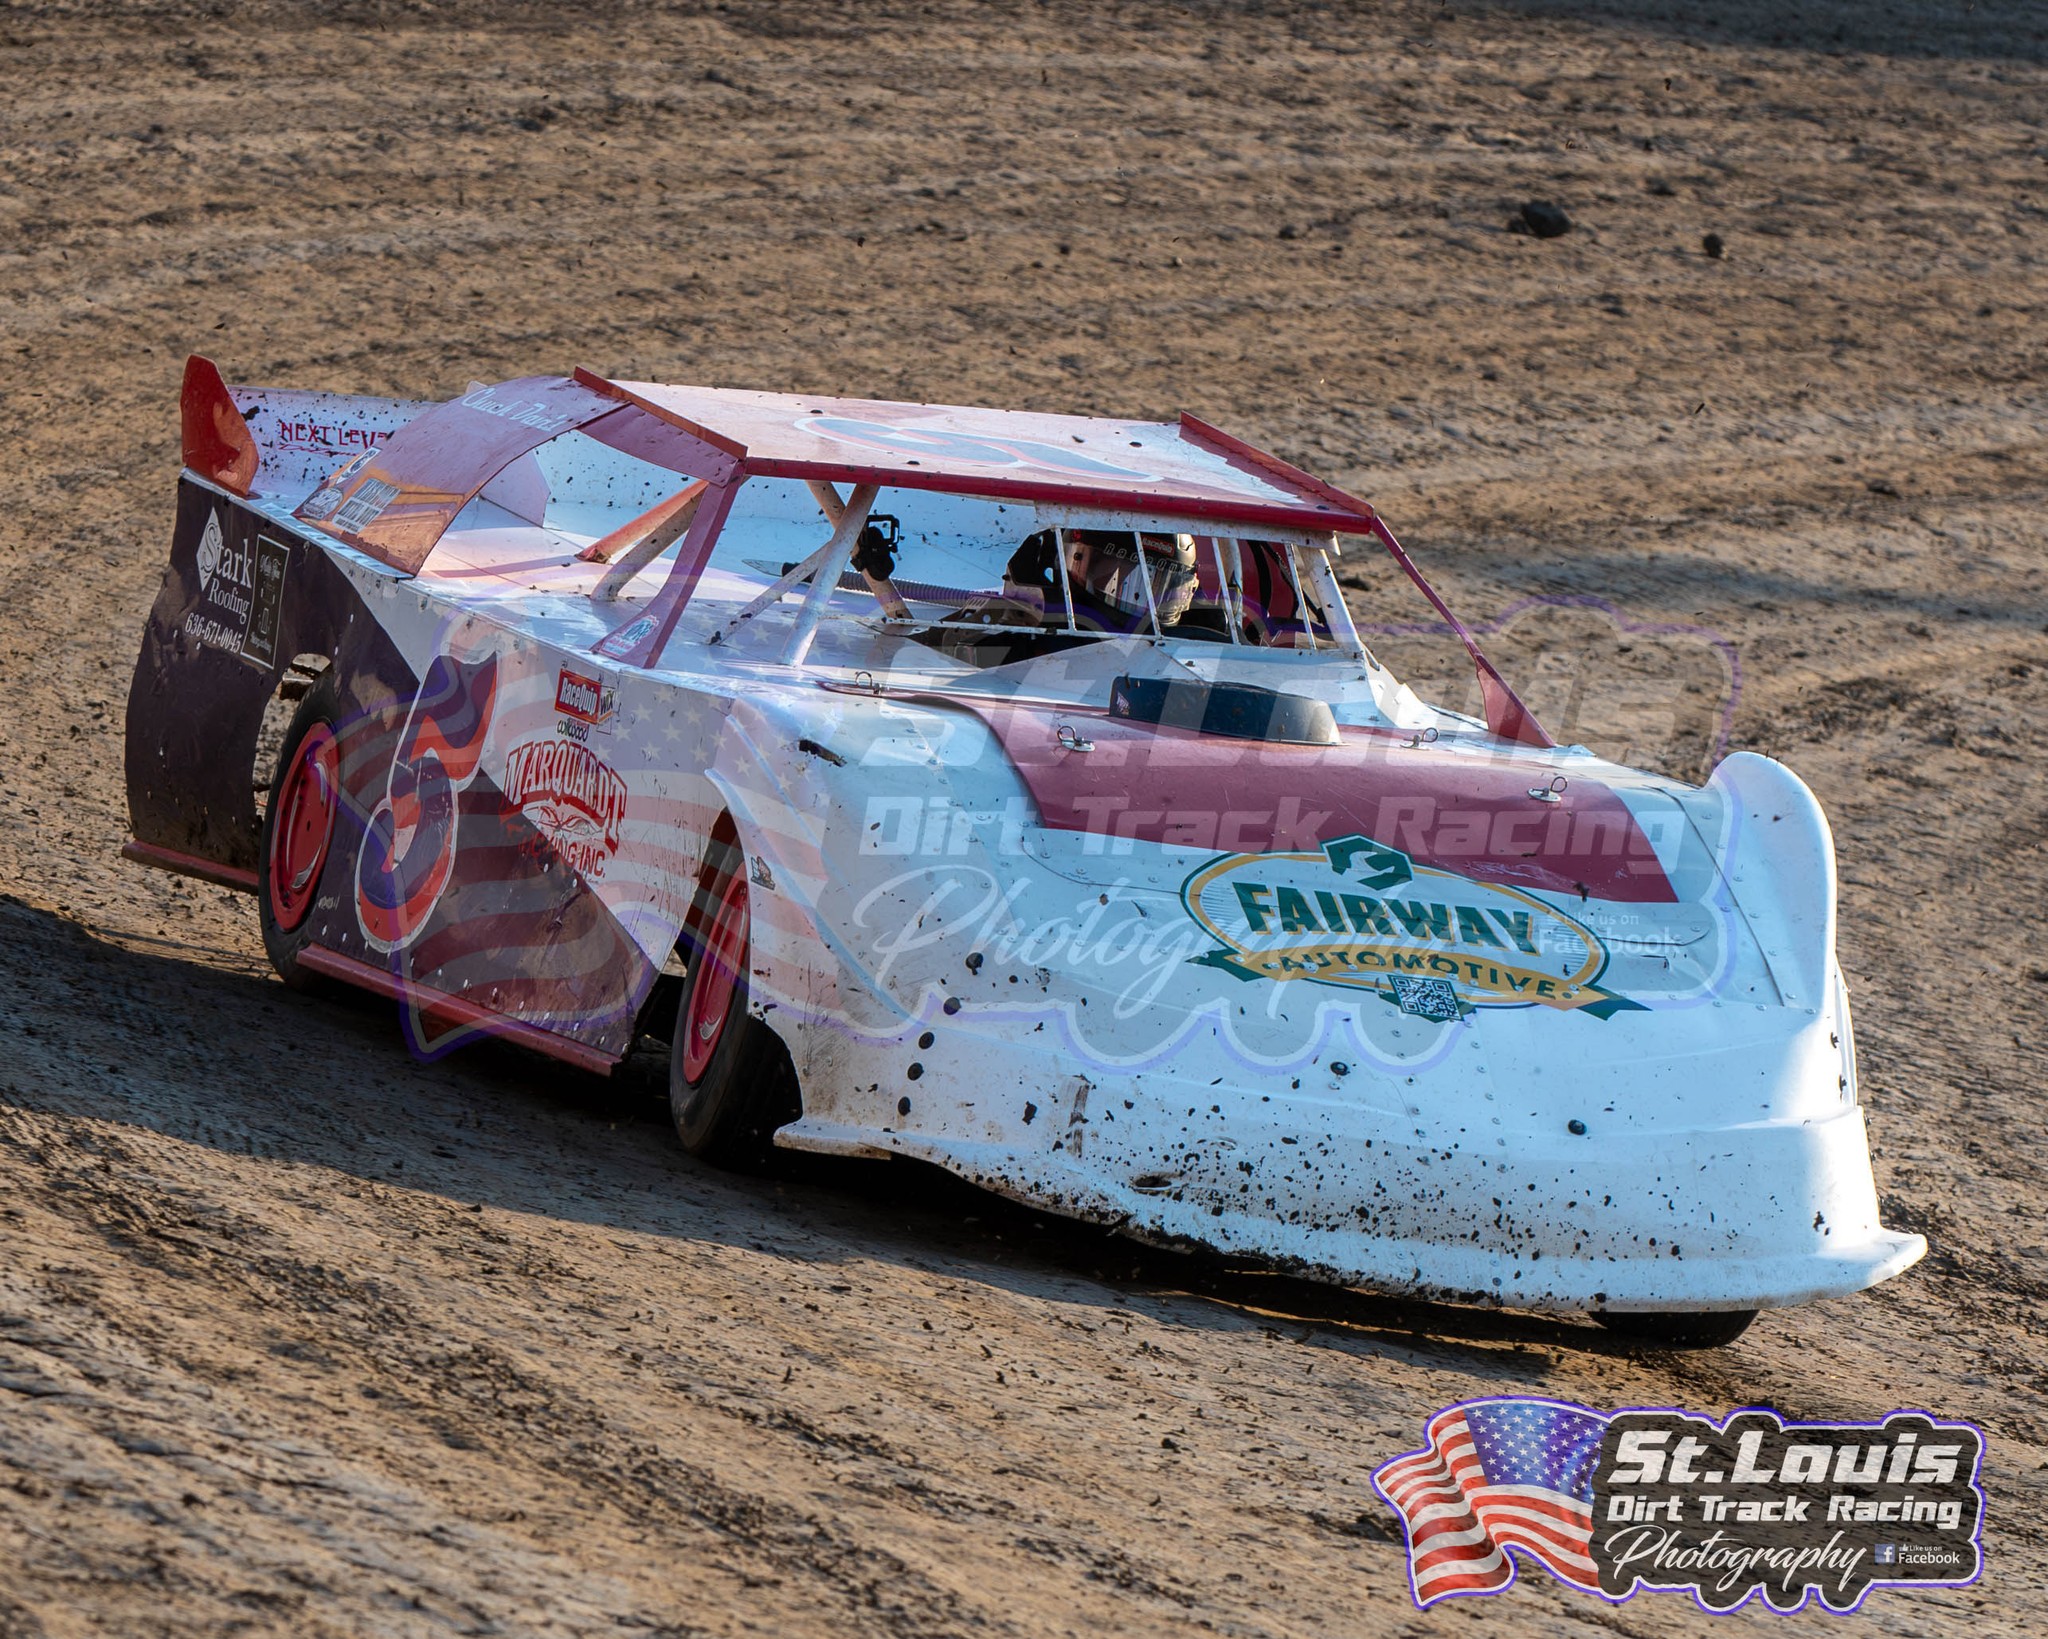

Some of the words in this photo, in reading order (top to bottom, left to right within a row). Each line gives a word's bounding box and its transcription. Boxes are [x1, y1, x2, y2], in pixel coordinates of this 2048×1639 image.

[281, 422, 331, 444] NEXT
[199, 520, 253, 589] Stark
[208, 577, 250, 625] Roofing
[184, 612, 243, 654] 636-671-0045
[560, 676, 598, 716] RaceQuip
[503, 739, 628, 857] MARQUARDT
[579, 845, 606, 878] INC.
[1232, 881, 1541, 957] FAIRWAY
